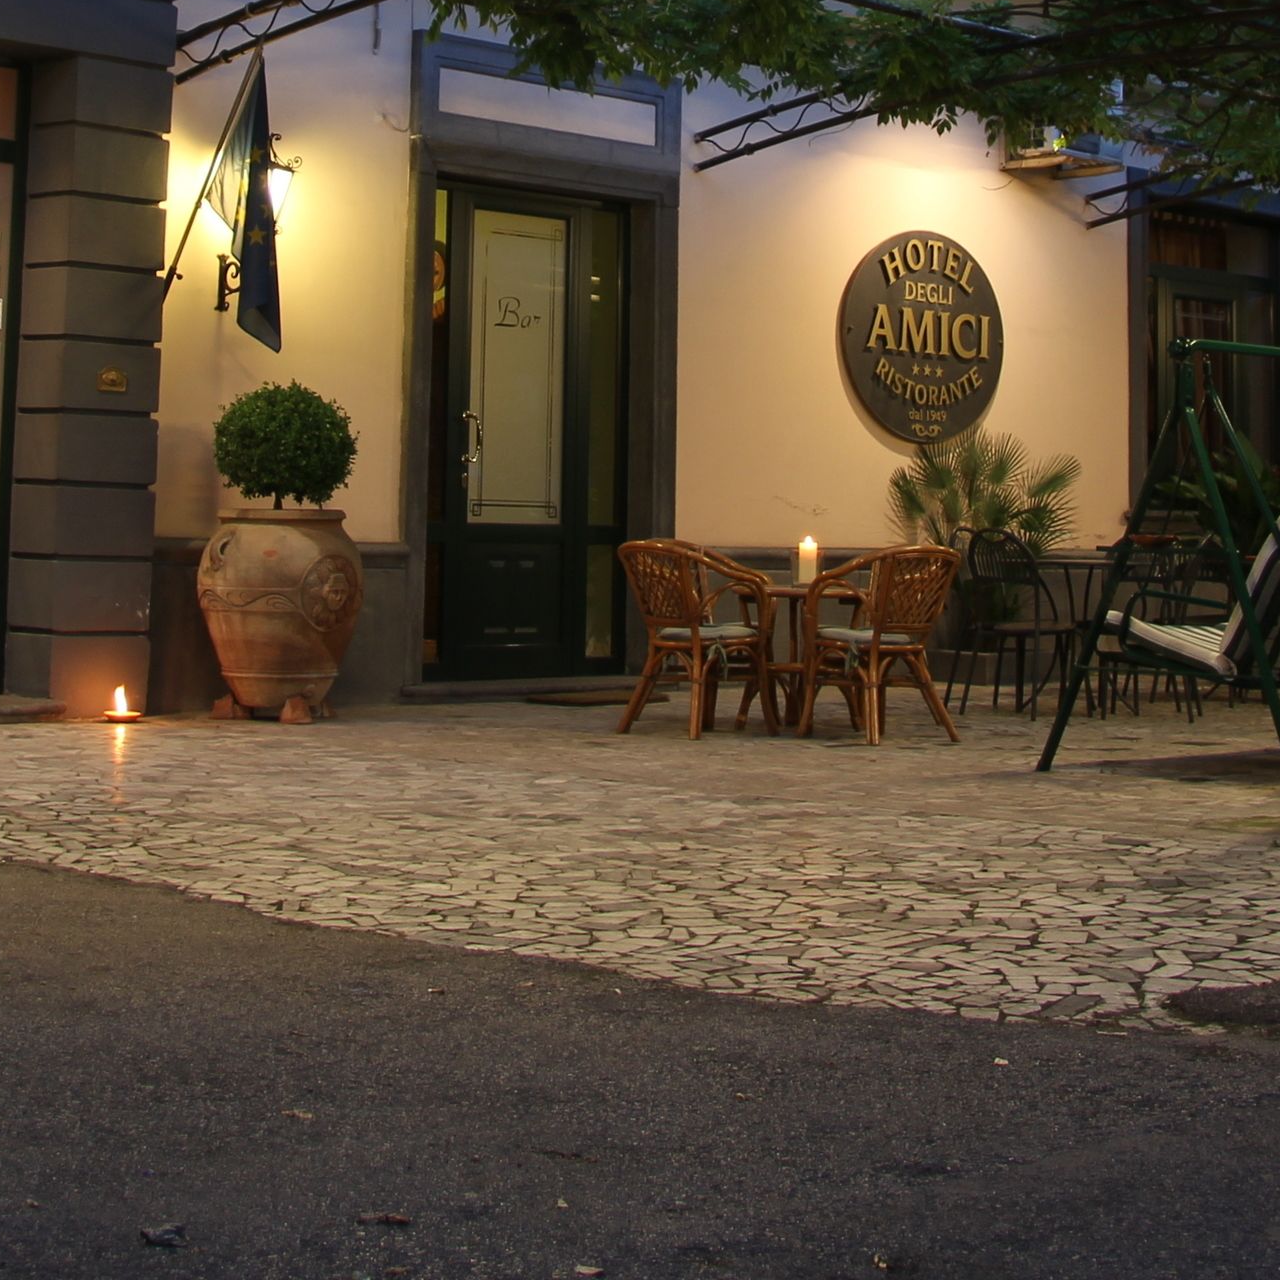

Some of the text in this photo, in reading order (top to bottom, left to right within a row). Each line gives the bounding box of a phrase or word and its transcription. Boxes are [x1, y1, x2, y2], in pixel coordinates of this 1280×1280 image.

[881, 238, 975, 294] HOTEL
[494, 296, 541, 328] Bar
[904, 281, 954, 305] DEGLI
[867, 303, 991, 360] AMICI
[875, 357, 983, 406] RISTORANTE
[908, 407, 947, 422] dal 1949
